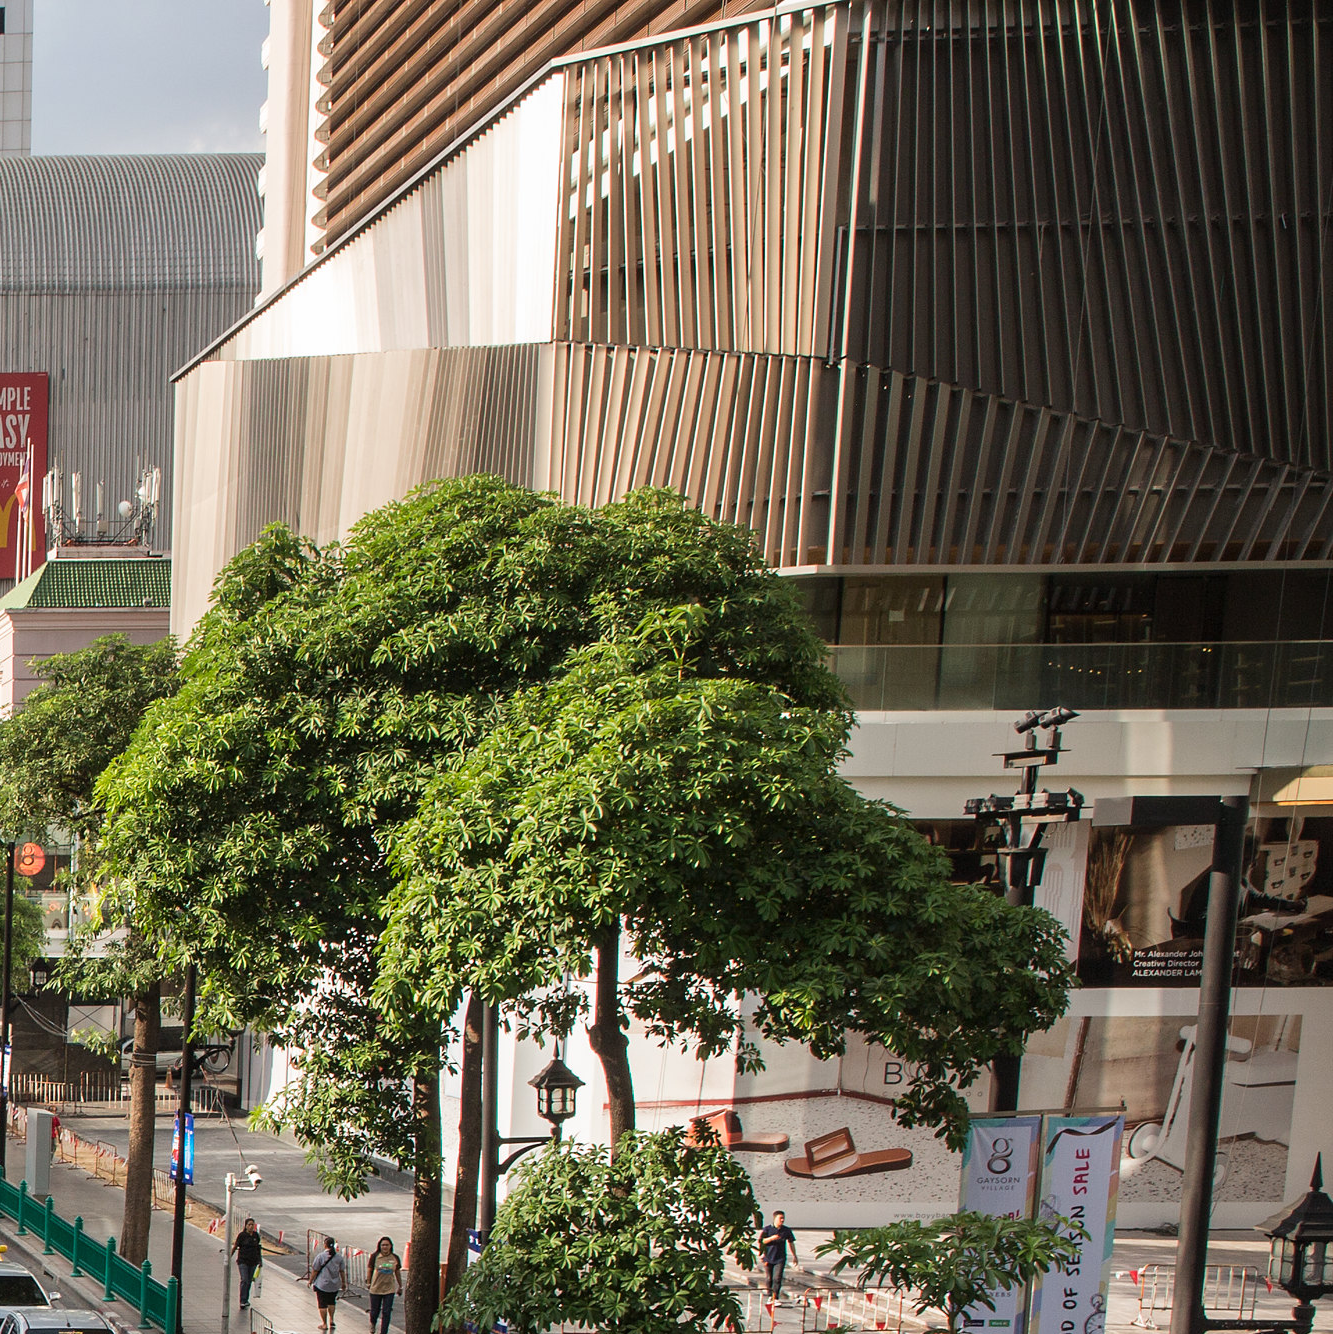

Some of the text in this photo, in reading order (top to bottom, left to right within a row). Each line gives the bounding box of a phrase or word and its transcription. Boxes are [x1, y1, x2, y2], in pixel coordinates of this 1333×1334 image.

[1134, 950, 1203, 958] Mr. Alexander Joh
[976, 1176, 1021, 1184] GAYSORN
[1072, 1148, 1090, 1196] SALE
[1065, 1205, 1085, 1277] SESN
[1062, 1287, 1079, 1310] OF
